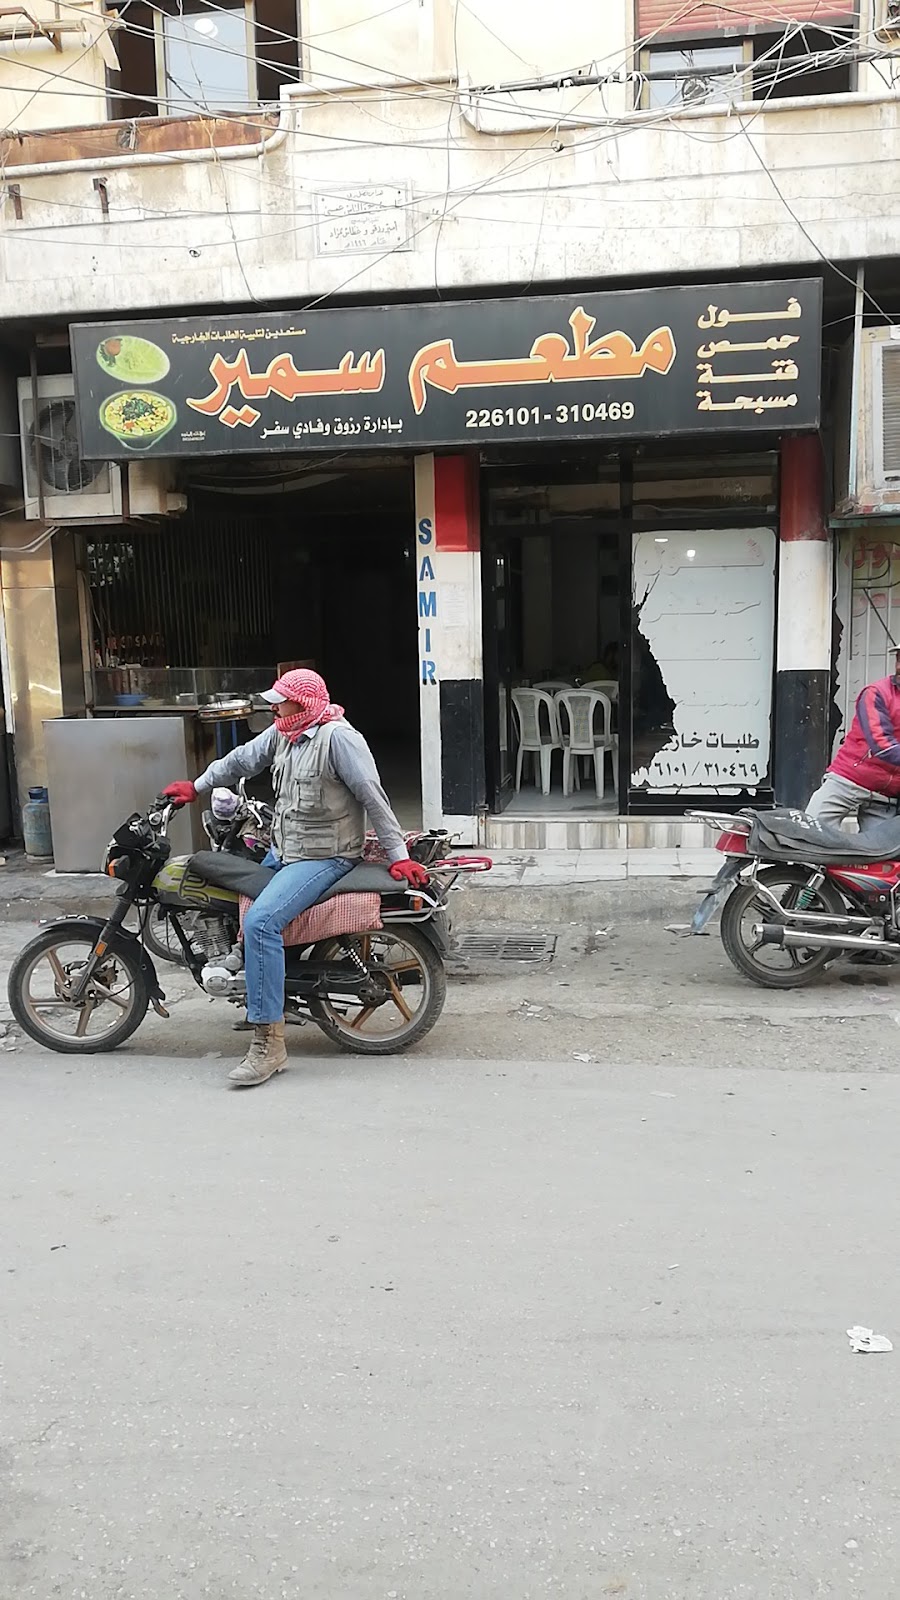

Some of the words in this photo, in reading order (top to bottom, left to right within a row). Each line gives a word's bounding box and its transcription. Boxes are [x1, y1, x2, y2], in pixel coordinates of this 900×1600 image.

[697, 297, 801, 329] فول
[172, 331, 211, 344] الخارجية
[210, 330, 240, 343] الطلبات
[240, 328, 265, 341] لتلبية
[265, 327, 306, 339] مستعدين
[697, 333, 800, 358] حمص
[408, 306, 676, 415] مطعم
[697, 359, 799, 384] فتة
[186, 348, 386, 428] سمير
[697, 390, 798, 414] مسبحة
[260, 421, 289, 439] سفر
[292, 418, 330, 439] وفادي
[333, 418, 361, 435] رزوق
[363, 416, 403, 434] بإدارة
[418, 518, 437, 686] SAMIR
[706, 731, 760, 753] طلبات
